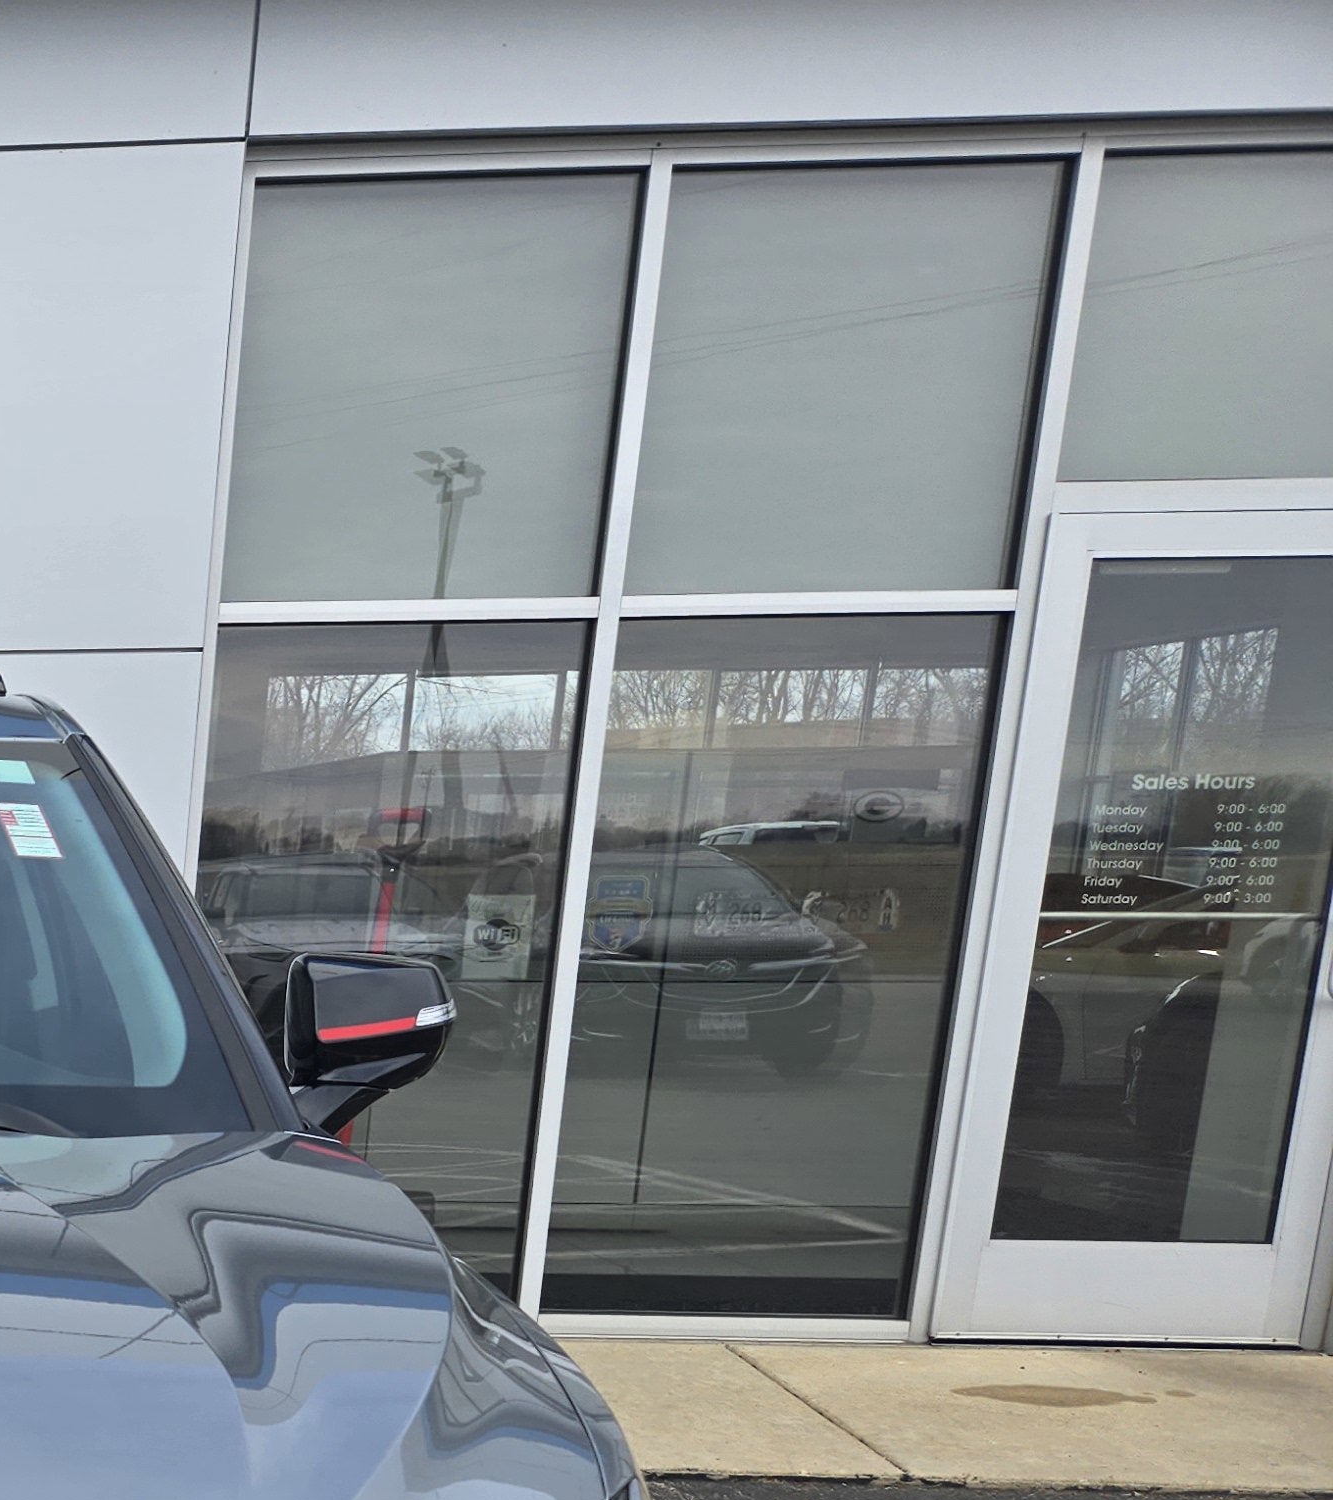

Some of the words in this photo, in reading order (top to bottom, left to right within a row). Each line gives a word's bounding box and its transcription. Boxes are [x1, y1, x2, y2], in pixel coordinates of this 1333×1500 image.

[1132, 773, 1189, 790] Sales
[1194, 773, 1256, 790] Hours
[1094, 804, 1147, 817] Monday
[1216, 803, 1245, 814] 9:00
[1258, 803, 1287, 814] 6:00
[1092, 822, 1144, 835] Tuesday
[1214, 821, 1242, 832] 9:00
[1254, 821, 1283, 832] 6:00
[1089, 840, 1164, 852] Wednesday
[1251, 839, 1280, 850] 6:00
[1086, 858, 1143, 870] Thursday
[1208, 857, 1237, 868] 9:00
[1249, 857, 1278, 868] 6:00
[1084, 876, 1123, 888] Friday
[1206, 875, 1234, 886] 9:00
[1246, 875, 1275, 886] 6:00
[1081, 893, 1138, 906] Saturday
[1203, 893, 1231, 904] 9:00
[1243, 893, 1272, 904] 3:00
